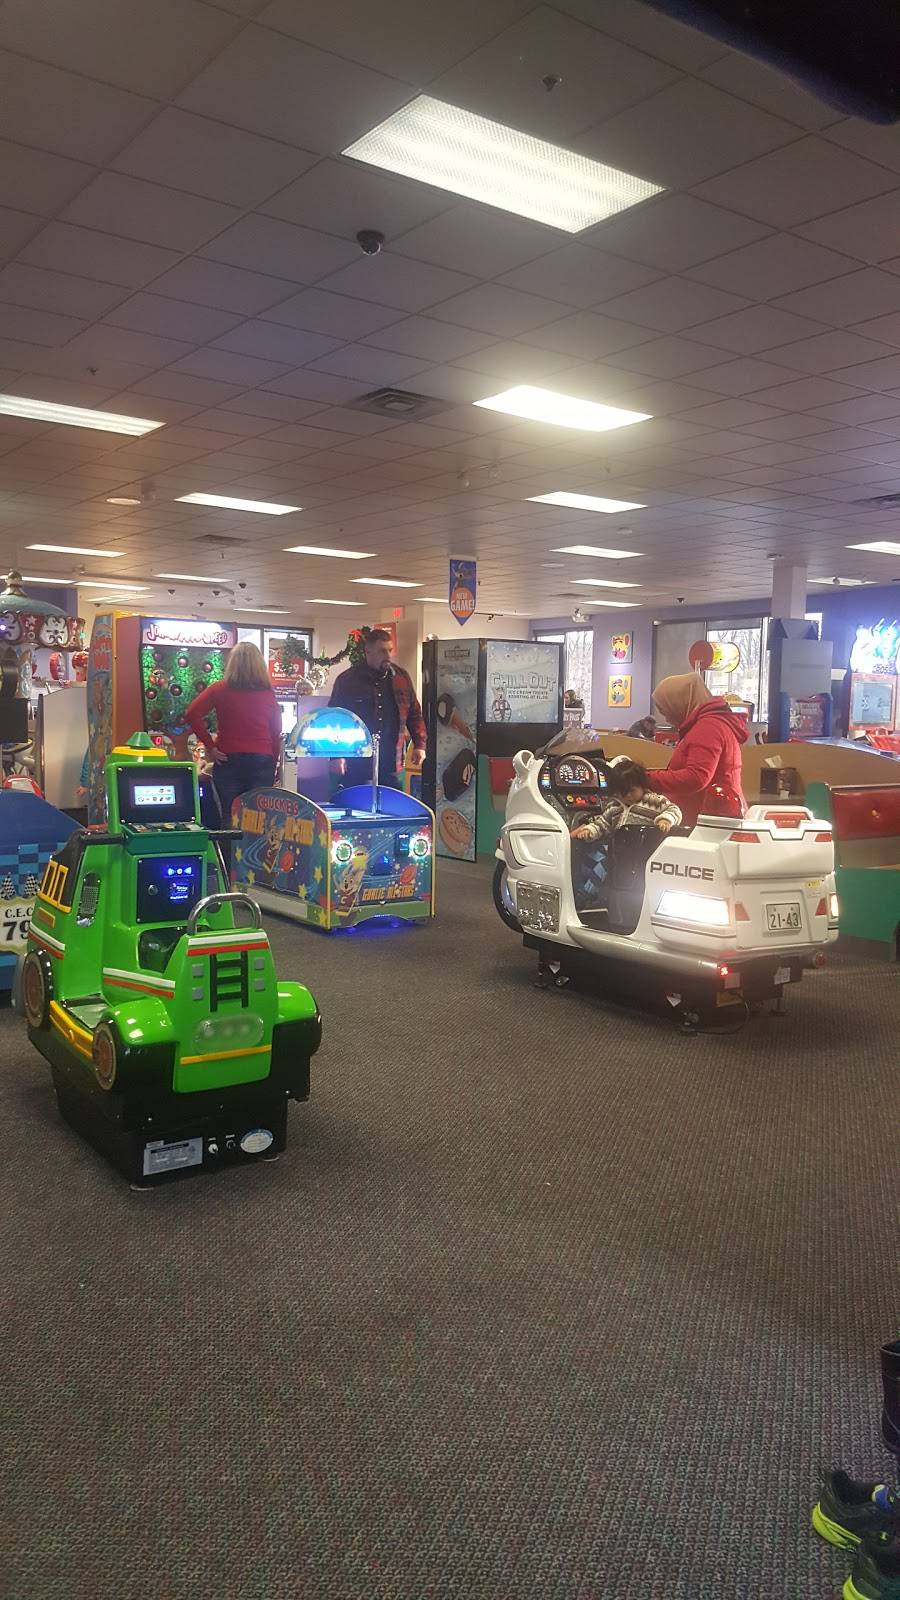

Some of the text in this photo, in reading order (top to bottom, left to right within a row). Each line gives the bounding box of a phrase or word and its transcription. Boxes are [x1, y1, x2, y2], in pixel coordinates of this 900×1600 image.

[450, 600, 475, 611] GAME!
[489, 671, 528, 689] CHILL
[528, 671, 557, 692] OUT
[650, 861, 714, 881] POLICE
[3, 919, 31, 941] 79
[770, 914, 799, 929] 21-43
